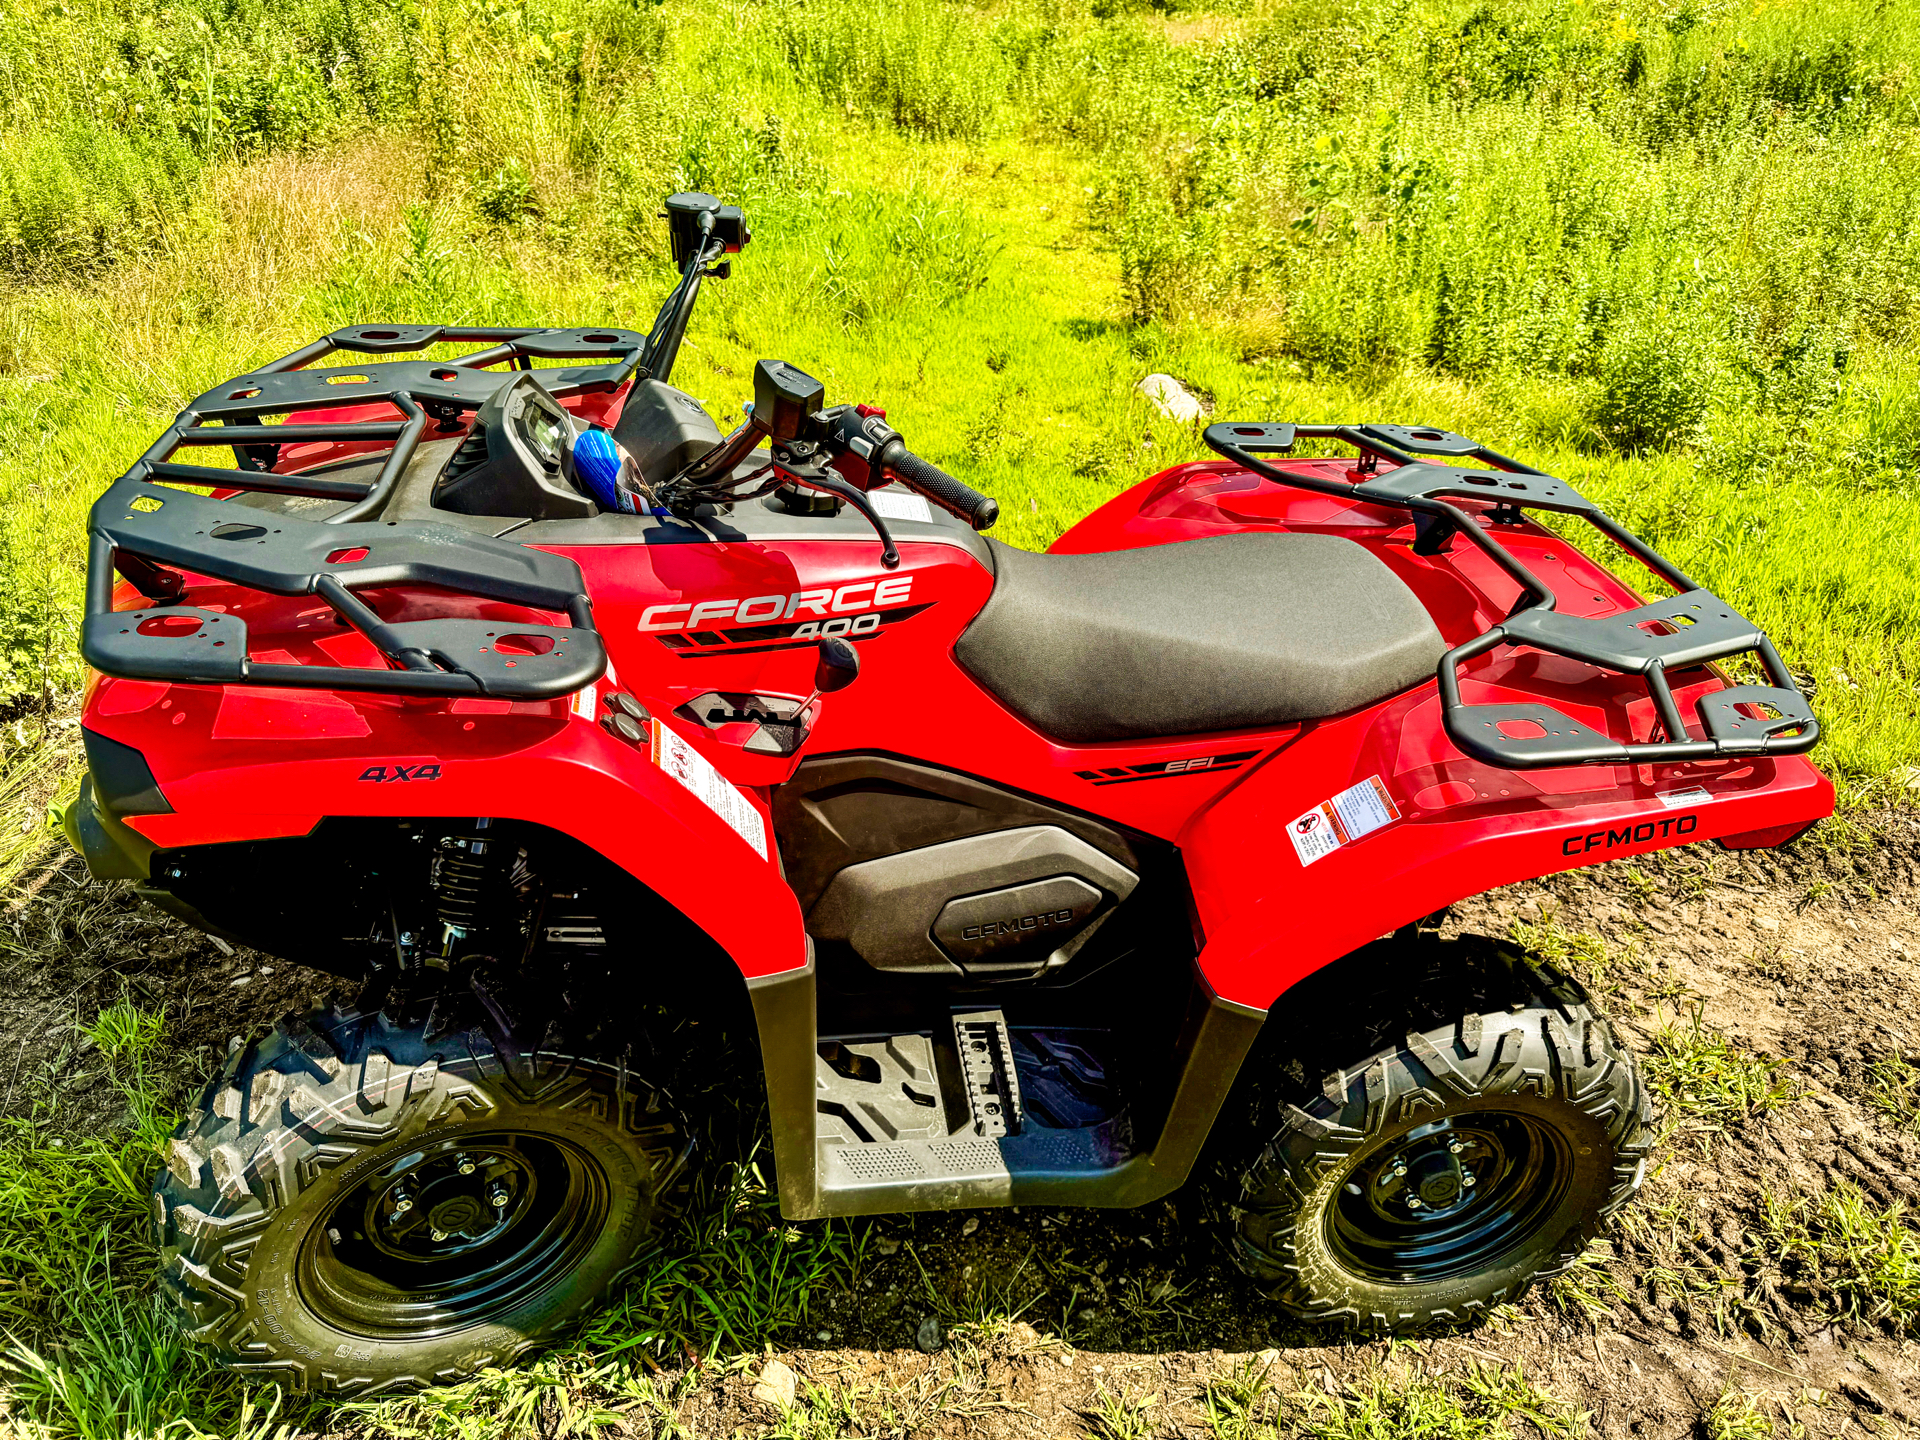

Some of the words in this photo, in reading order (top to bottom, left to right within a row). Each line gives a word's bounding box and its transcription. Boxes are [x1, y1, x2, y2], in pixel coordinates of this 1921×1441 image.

[637, 576, 914, 632] CFORCE
[791, 614, 881, 640] 400
[357, 764, 442, 783] 4X4
[1164, 756, 1215, 773] EFI
[1378, 789, 1393, 811] WARNING
[1328, 815, 1342, 836] WARNING
[1561, 814, 1698, 857] CFMOTO
[961, 908, 1073, 941] CFMOTO
